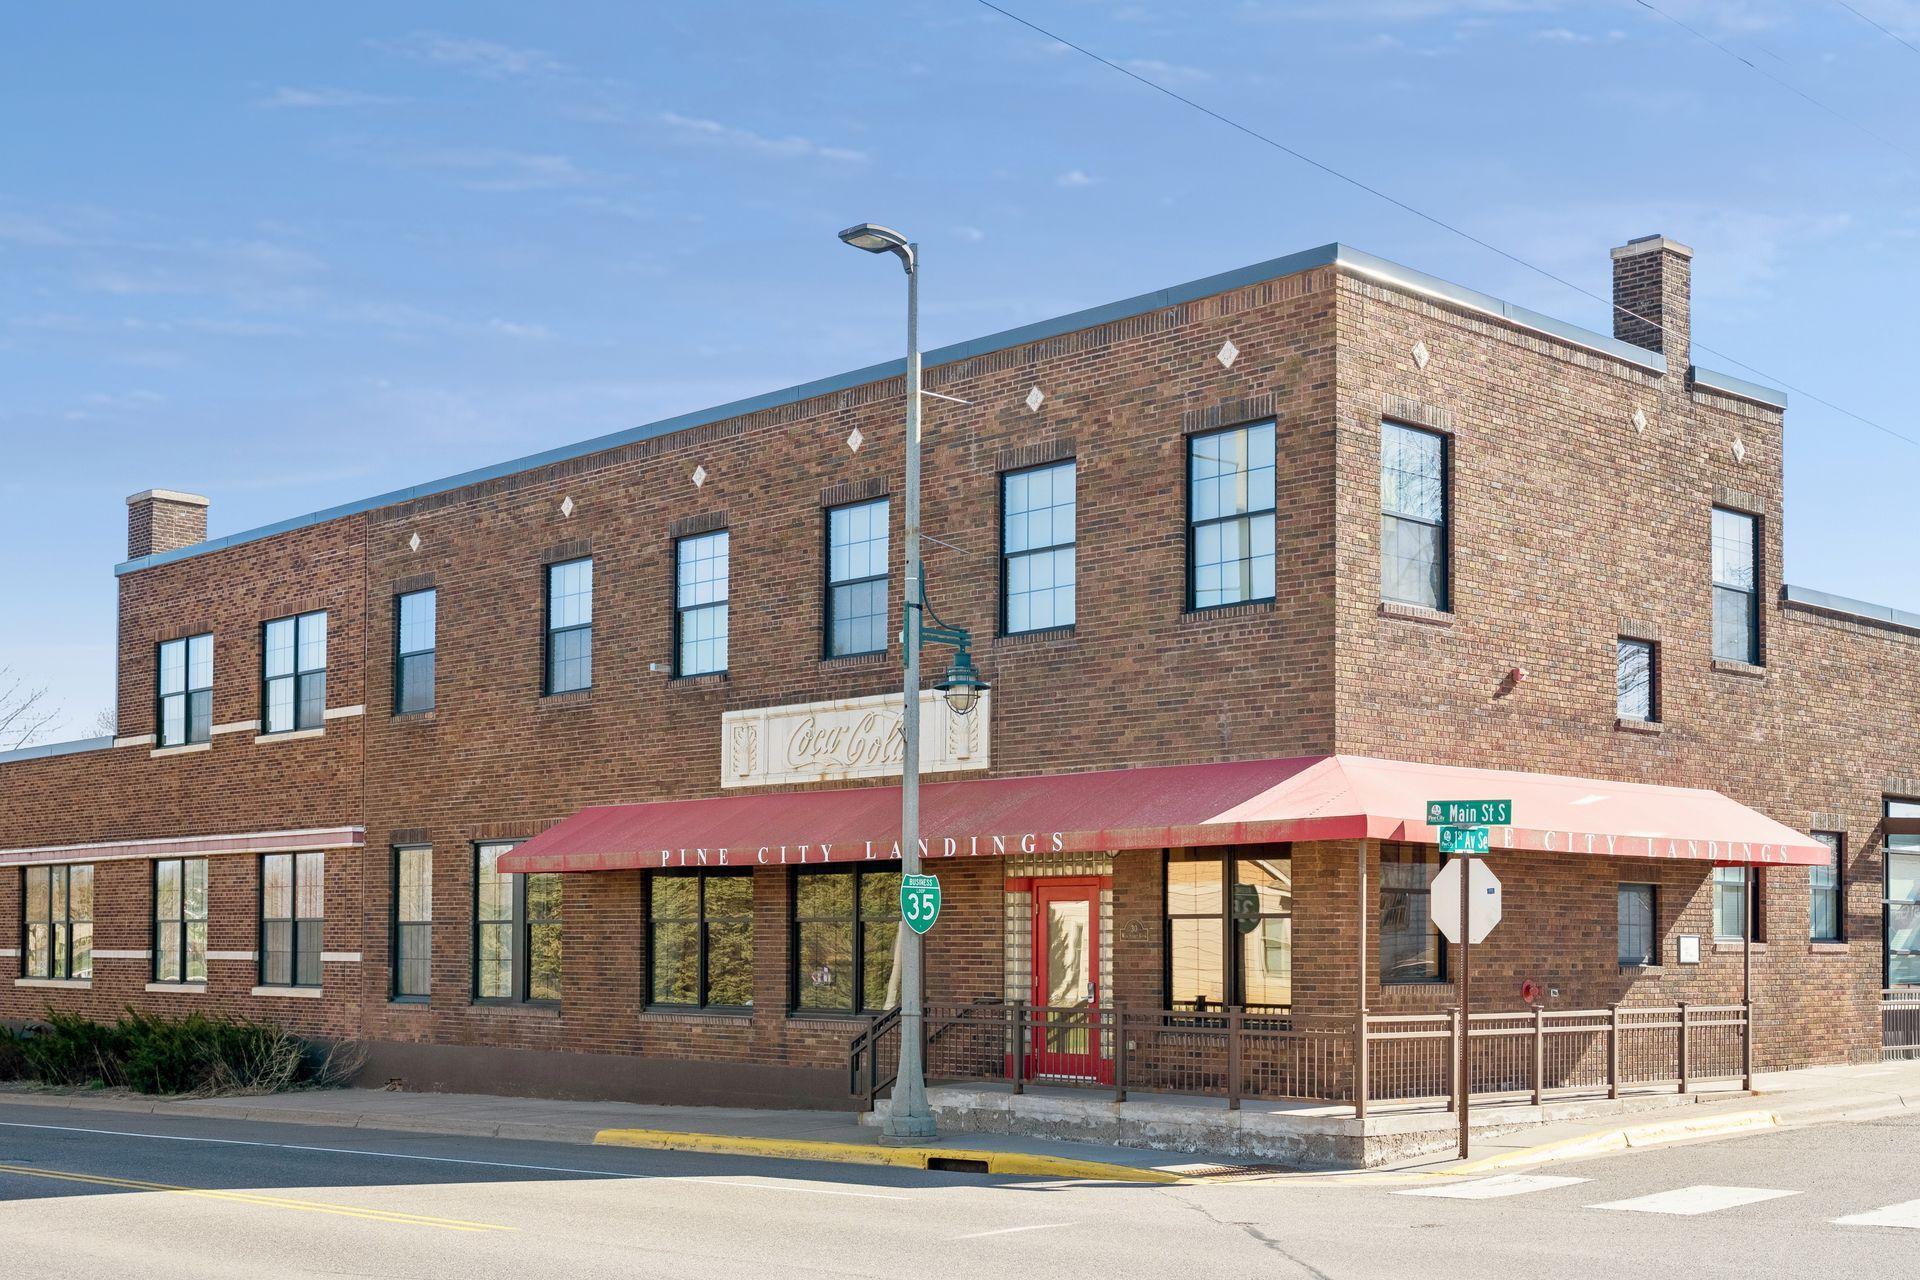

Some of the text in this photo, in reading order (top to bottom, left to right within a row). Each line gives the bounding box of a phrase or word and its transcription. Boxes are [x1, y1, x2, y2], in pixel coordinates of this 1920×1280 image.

[1449, 803, 1506, 822] Main St S
[661, 831, 1064, 867] PINE CITY LANDINGS
[1464, 831, 1476, 849] Av
[1544, 831, 1789, 864] CITY LANDINGS
[909, 878, 933, 887] BUSINESS
[907, 893, 935, 920] 35
